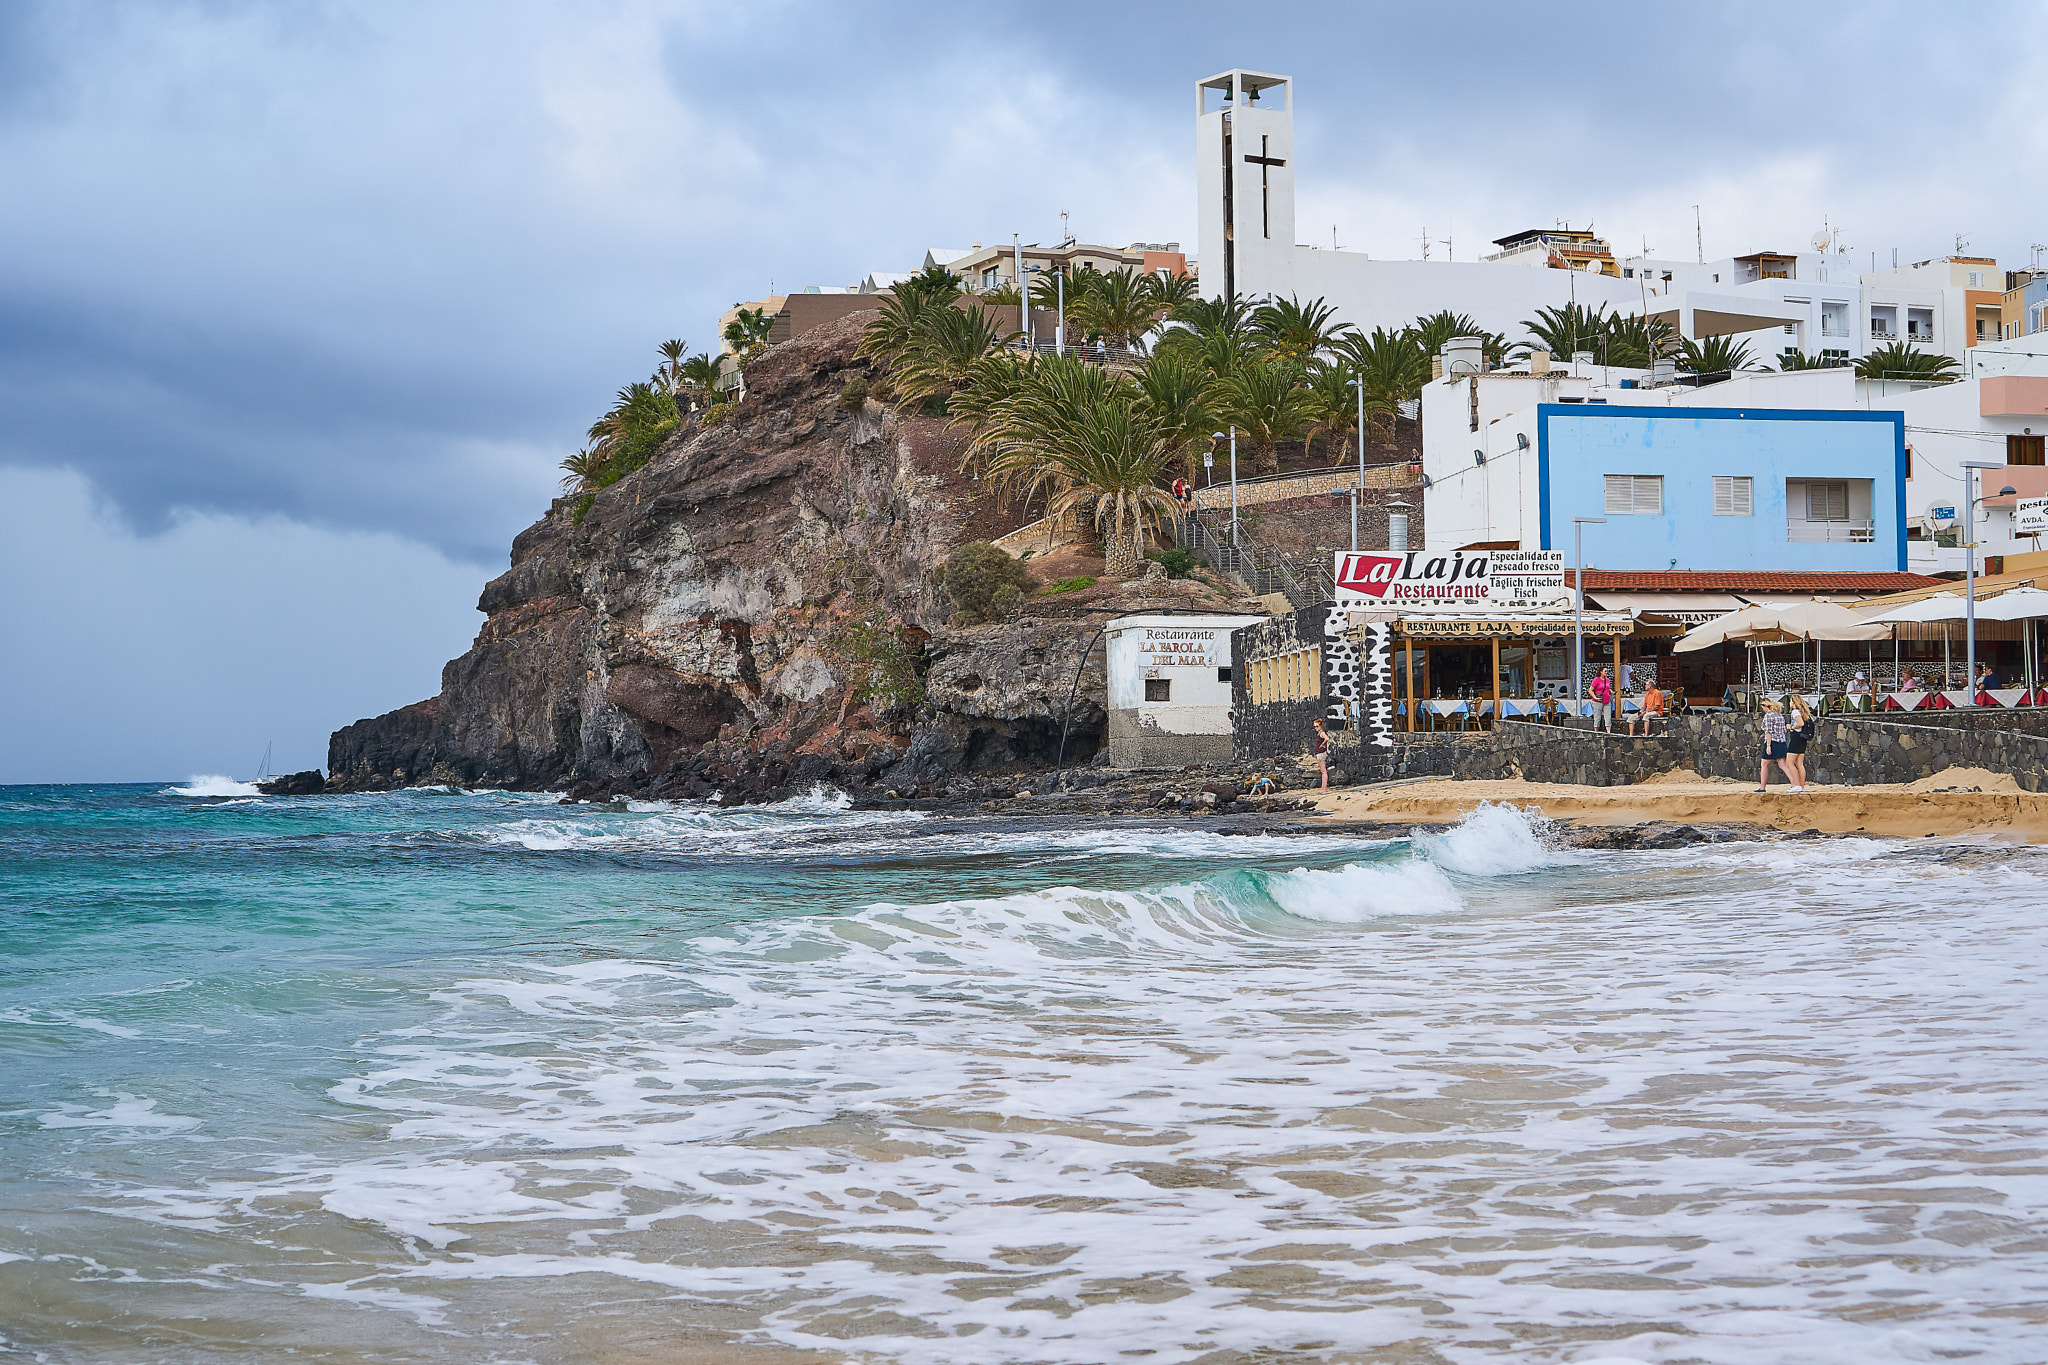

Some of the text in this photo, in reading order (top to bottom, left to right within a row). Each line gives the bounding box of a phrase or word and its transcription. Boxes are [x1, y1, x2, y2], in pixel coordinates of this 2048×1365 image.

[1490, 551, 1562, 562] Especialidad en
[1341, 552, 1489, 585] La Laja
[1492, 561, 1560, 573] pescado fresco
[1490, 577, 1563, 590] Täglich frischer
[1393, 583, 1489, 598] Restaurante
[1514, 588, 1538, 598] Fisch
[1406, 622, 1630, 633] RESTAURANTE LAJA Especialidad en escado Fresco
[1145, 629, 1215, 640] Restaurante
[1140, 642, 1205, 653] LA FAROLA
[1152, 655, 1206, 666] DEL MAR
